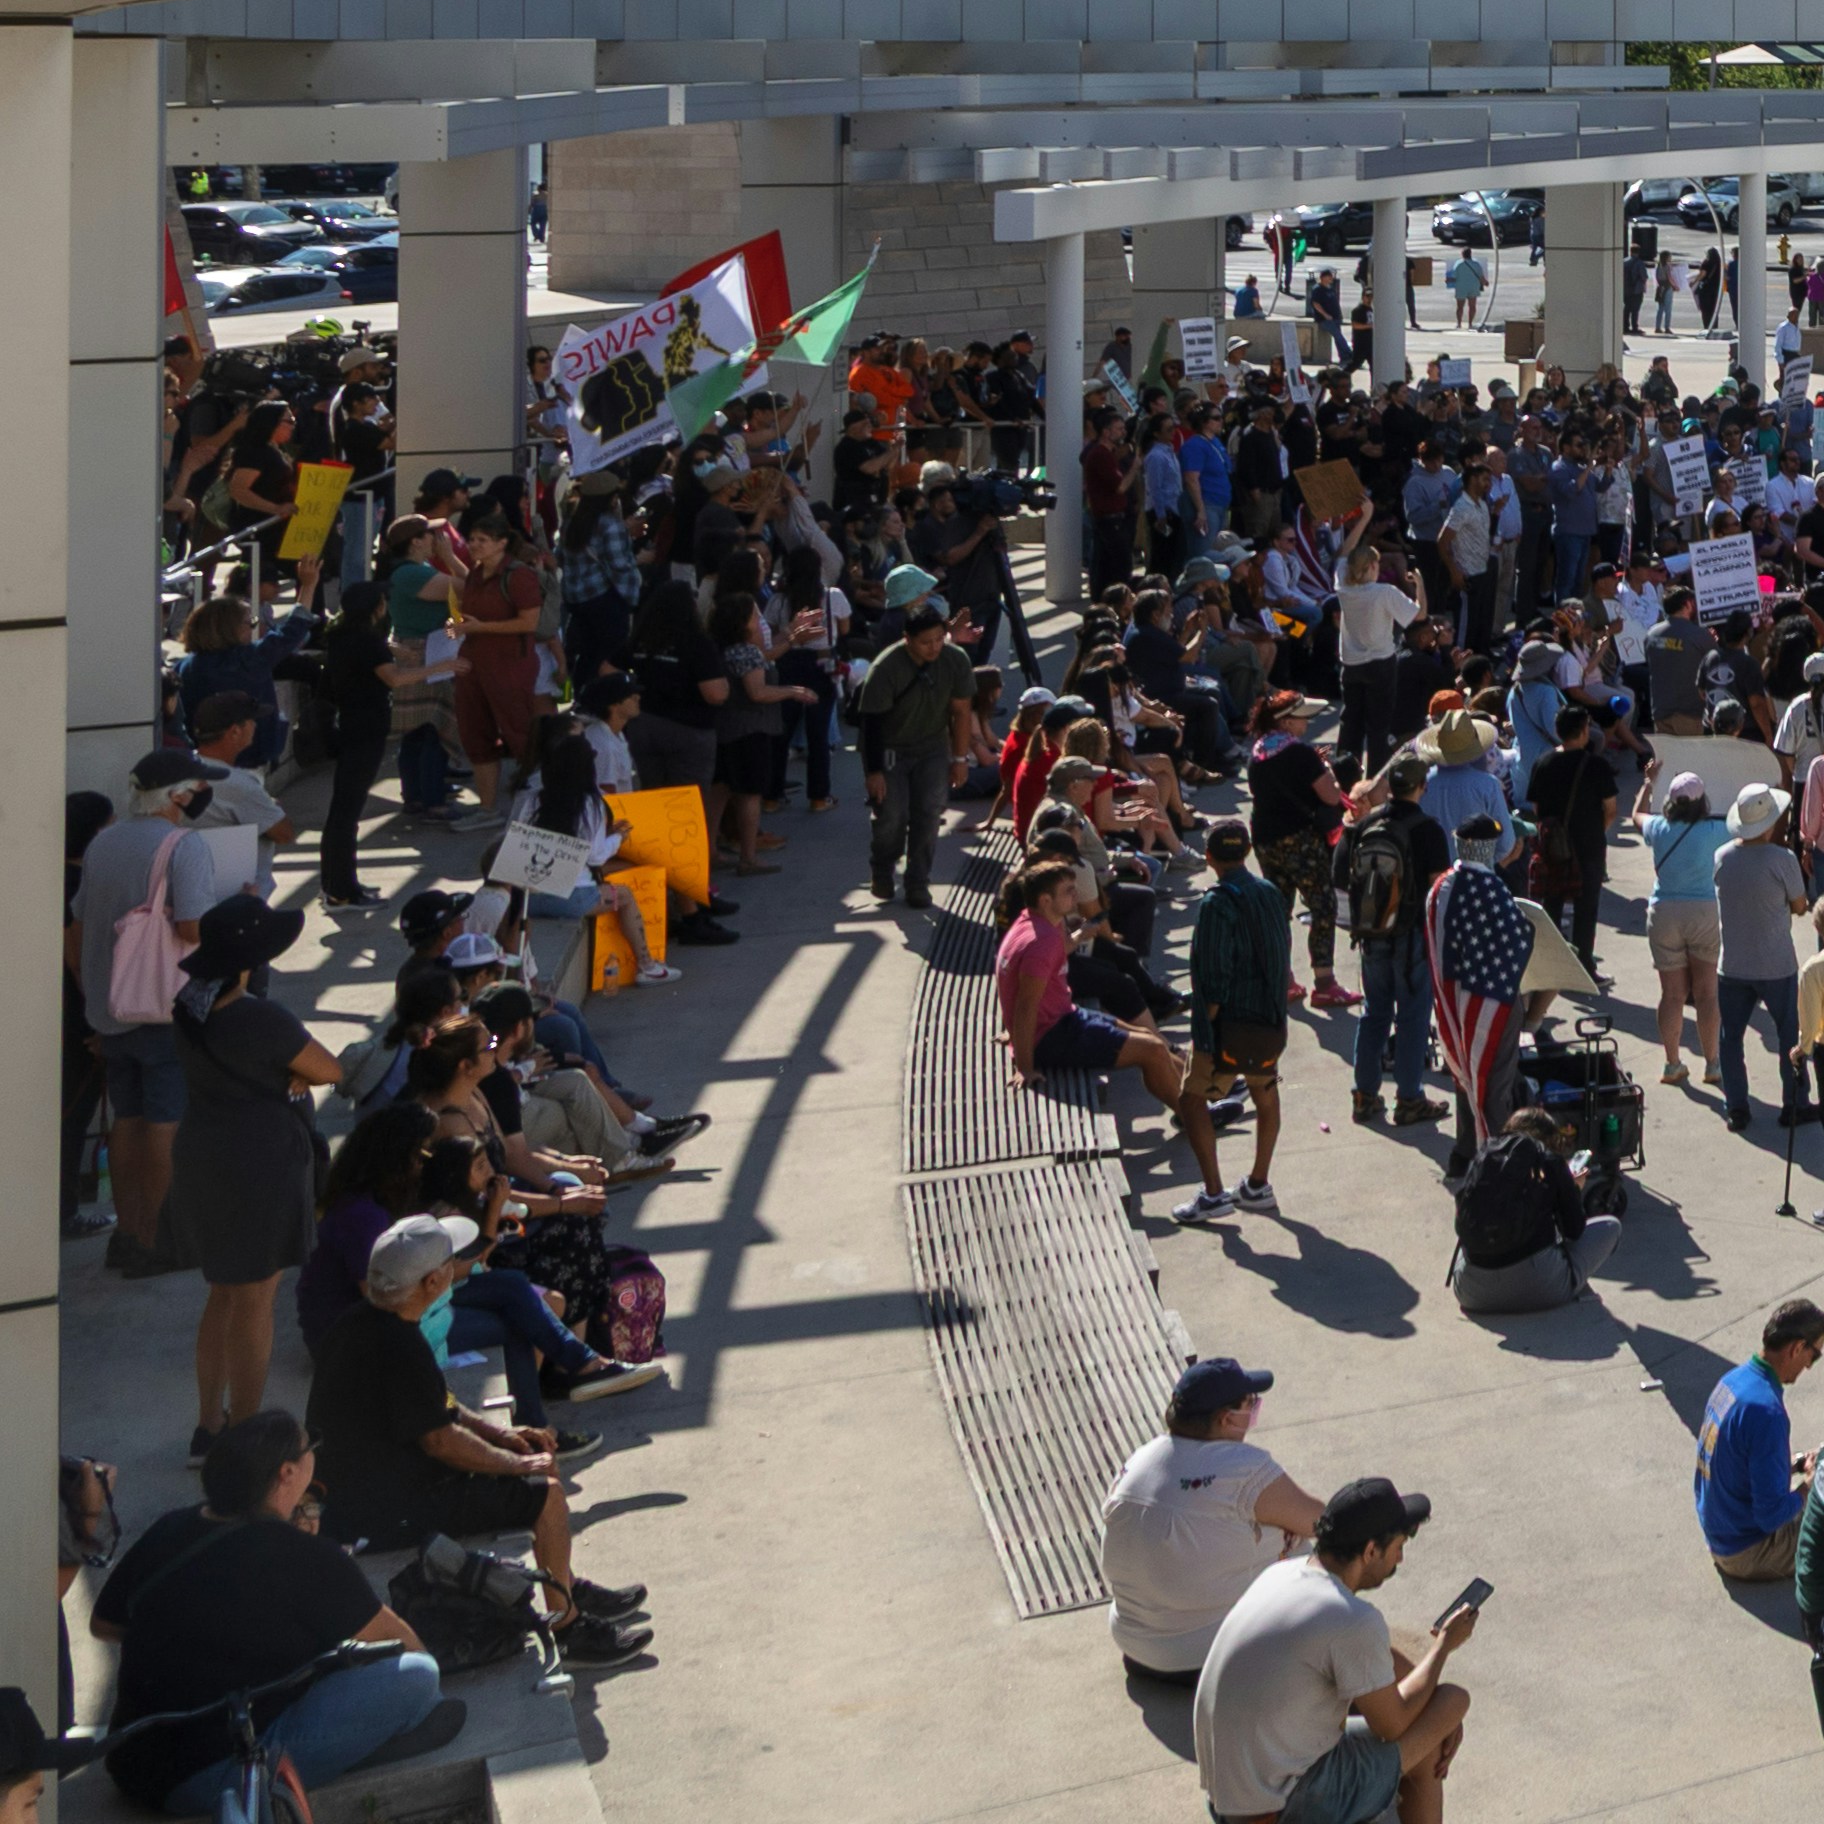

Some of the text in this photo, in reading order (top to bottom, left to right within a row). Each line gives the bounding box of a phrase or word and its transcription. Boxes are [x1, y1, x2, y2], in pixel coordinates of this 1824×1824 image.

[1680, 443, 1691, 453] NO
[1696, 538, 1748, 555] EL PUEBLO
[1698, 562, 1752, 576] LA AGENDA
[1701, 595, 1715, 606] DE
[557, 835, 591, 852] Miller
